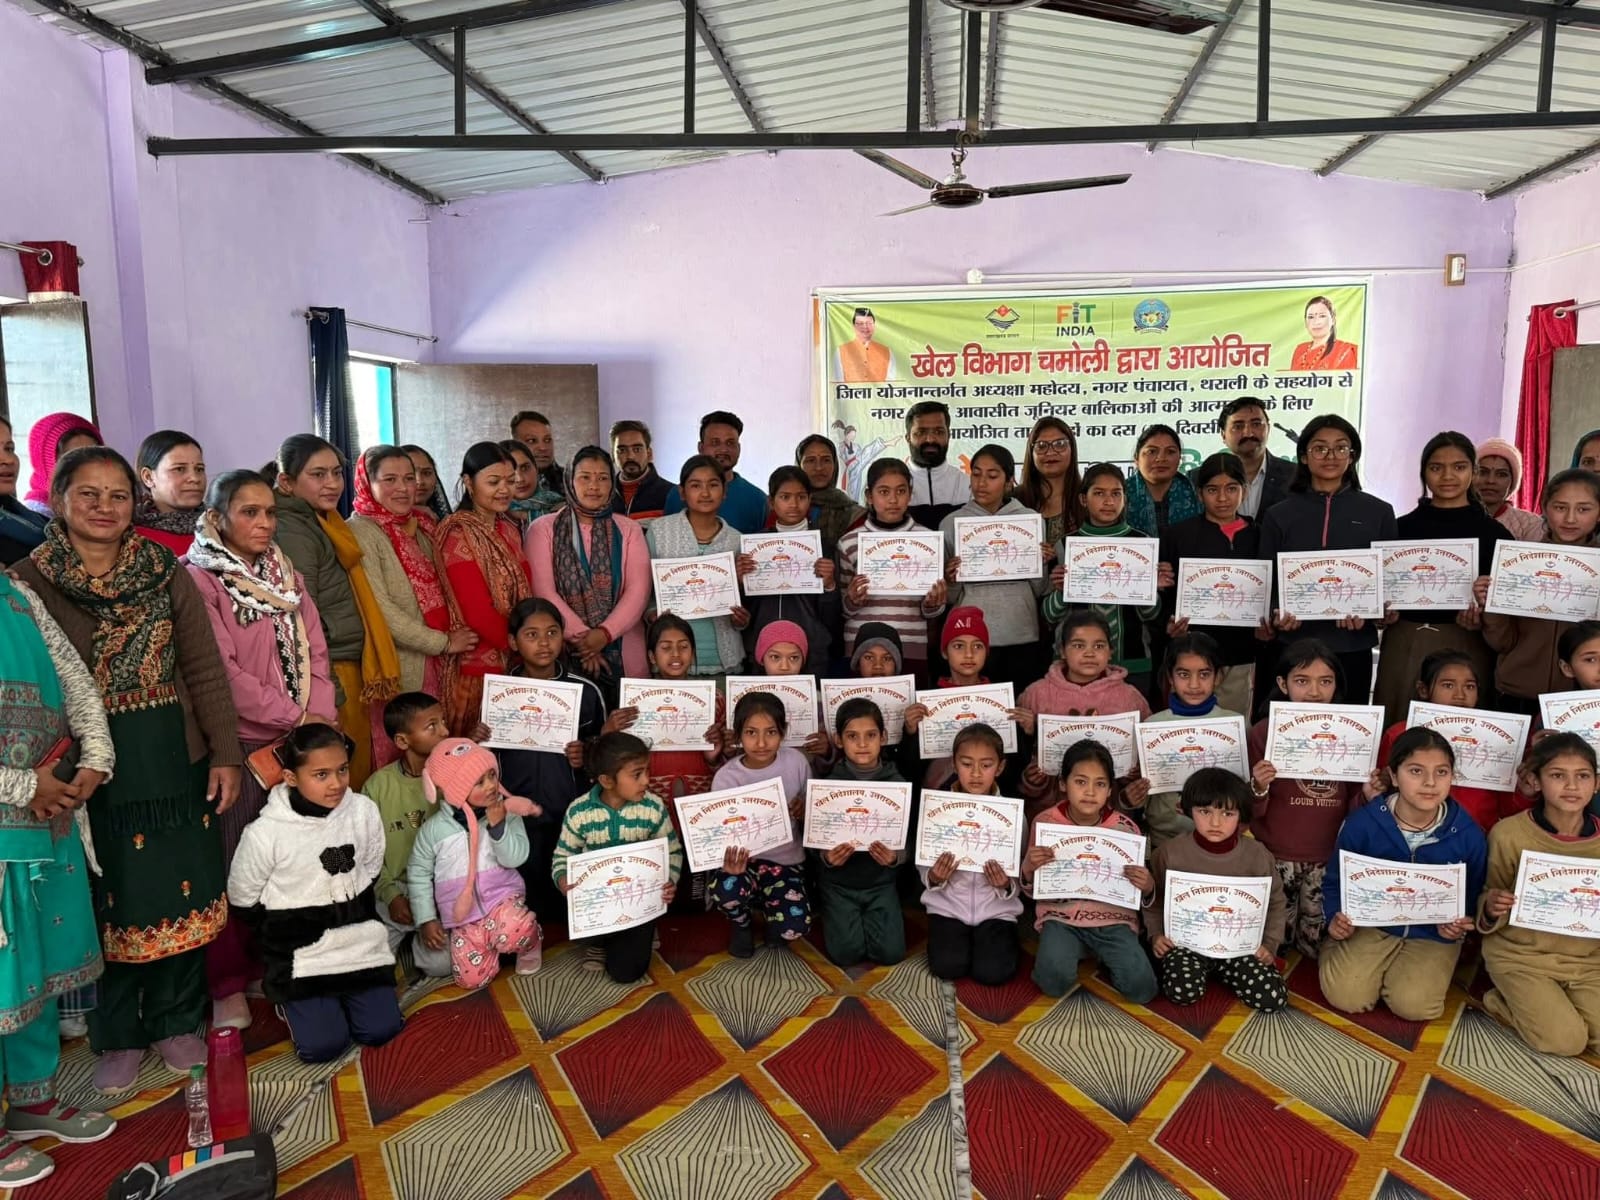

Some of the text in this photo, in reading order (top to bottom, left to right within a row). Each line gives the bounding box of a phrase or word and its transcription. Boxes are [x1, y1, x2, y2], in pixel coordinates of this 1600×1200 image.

[1056, 325, 1095, 337] INDIA
[911, 334, 1271, 378] खेल विभाग चमोली द्वारा आयोजित
[836, 384, 872, 400] जिला
[876, 382, 967, 399] योजनान्तर्गत
[972, 382, 1025, 398] अध्यक्षा
[1092, 381, 1128, 394] नगर
[1200, 374, 1248, 391] थराली
[1253, 373, 1269, 389] के
[1275, 373, 1333, 389] सहयोग
[1338, 371, 1354, 388] से
[871, 406, 905, 420] नगर
[956, 402, 1019, 419] आवासीत
[1024, 401, 1077, 420] जूनियर
[1081, 398, 1158, 417] बालिकाओं
[1161, 397, 1184, 414] की
[1282, 394, 1314, 411] लिए
[1086, 423, 1107, 437] का
[1111, 424, 1136, 436] दस
[1176, 419, 1220, 435] दिवसी
[1290, 797, 1314, 806] LOUIS
